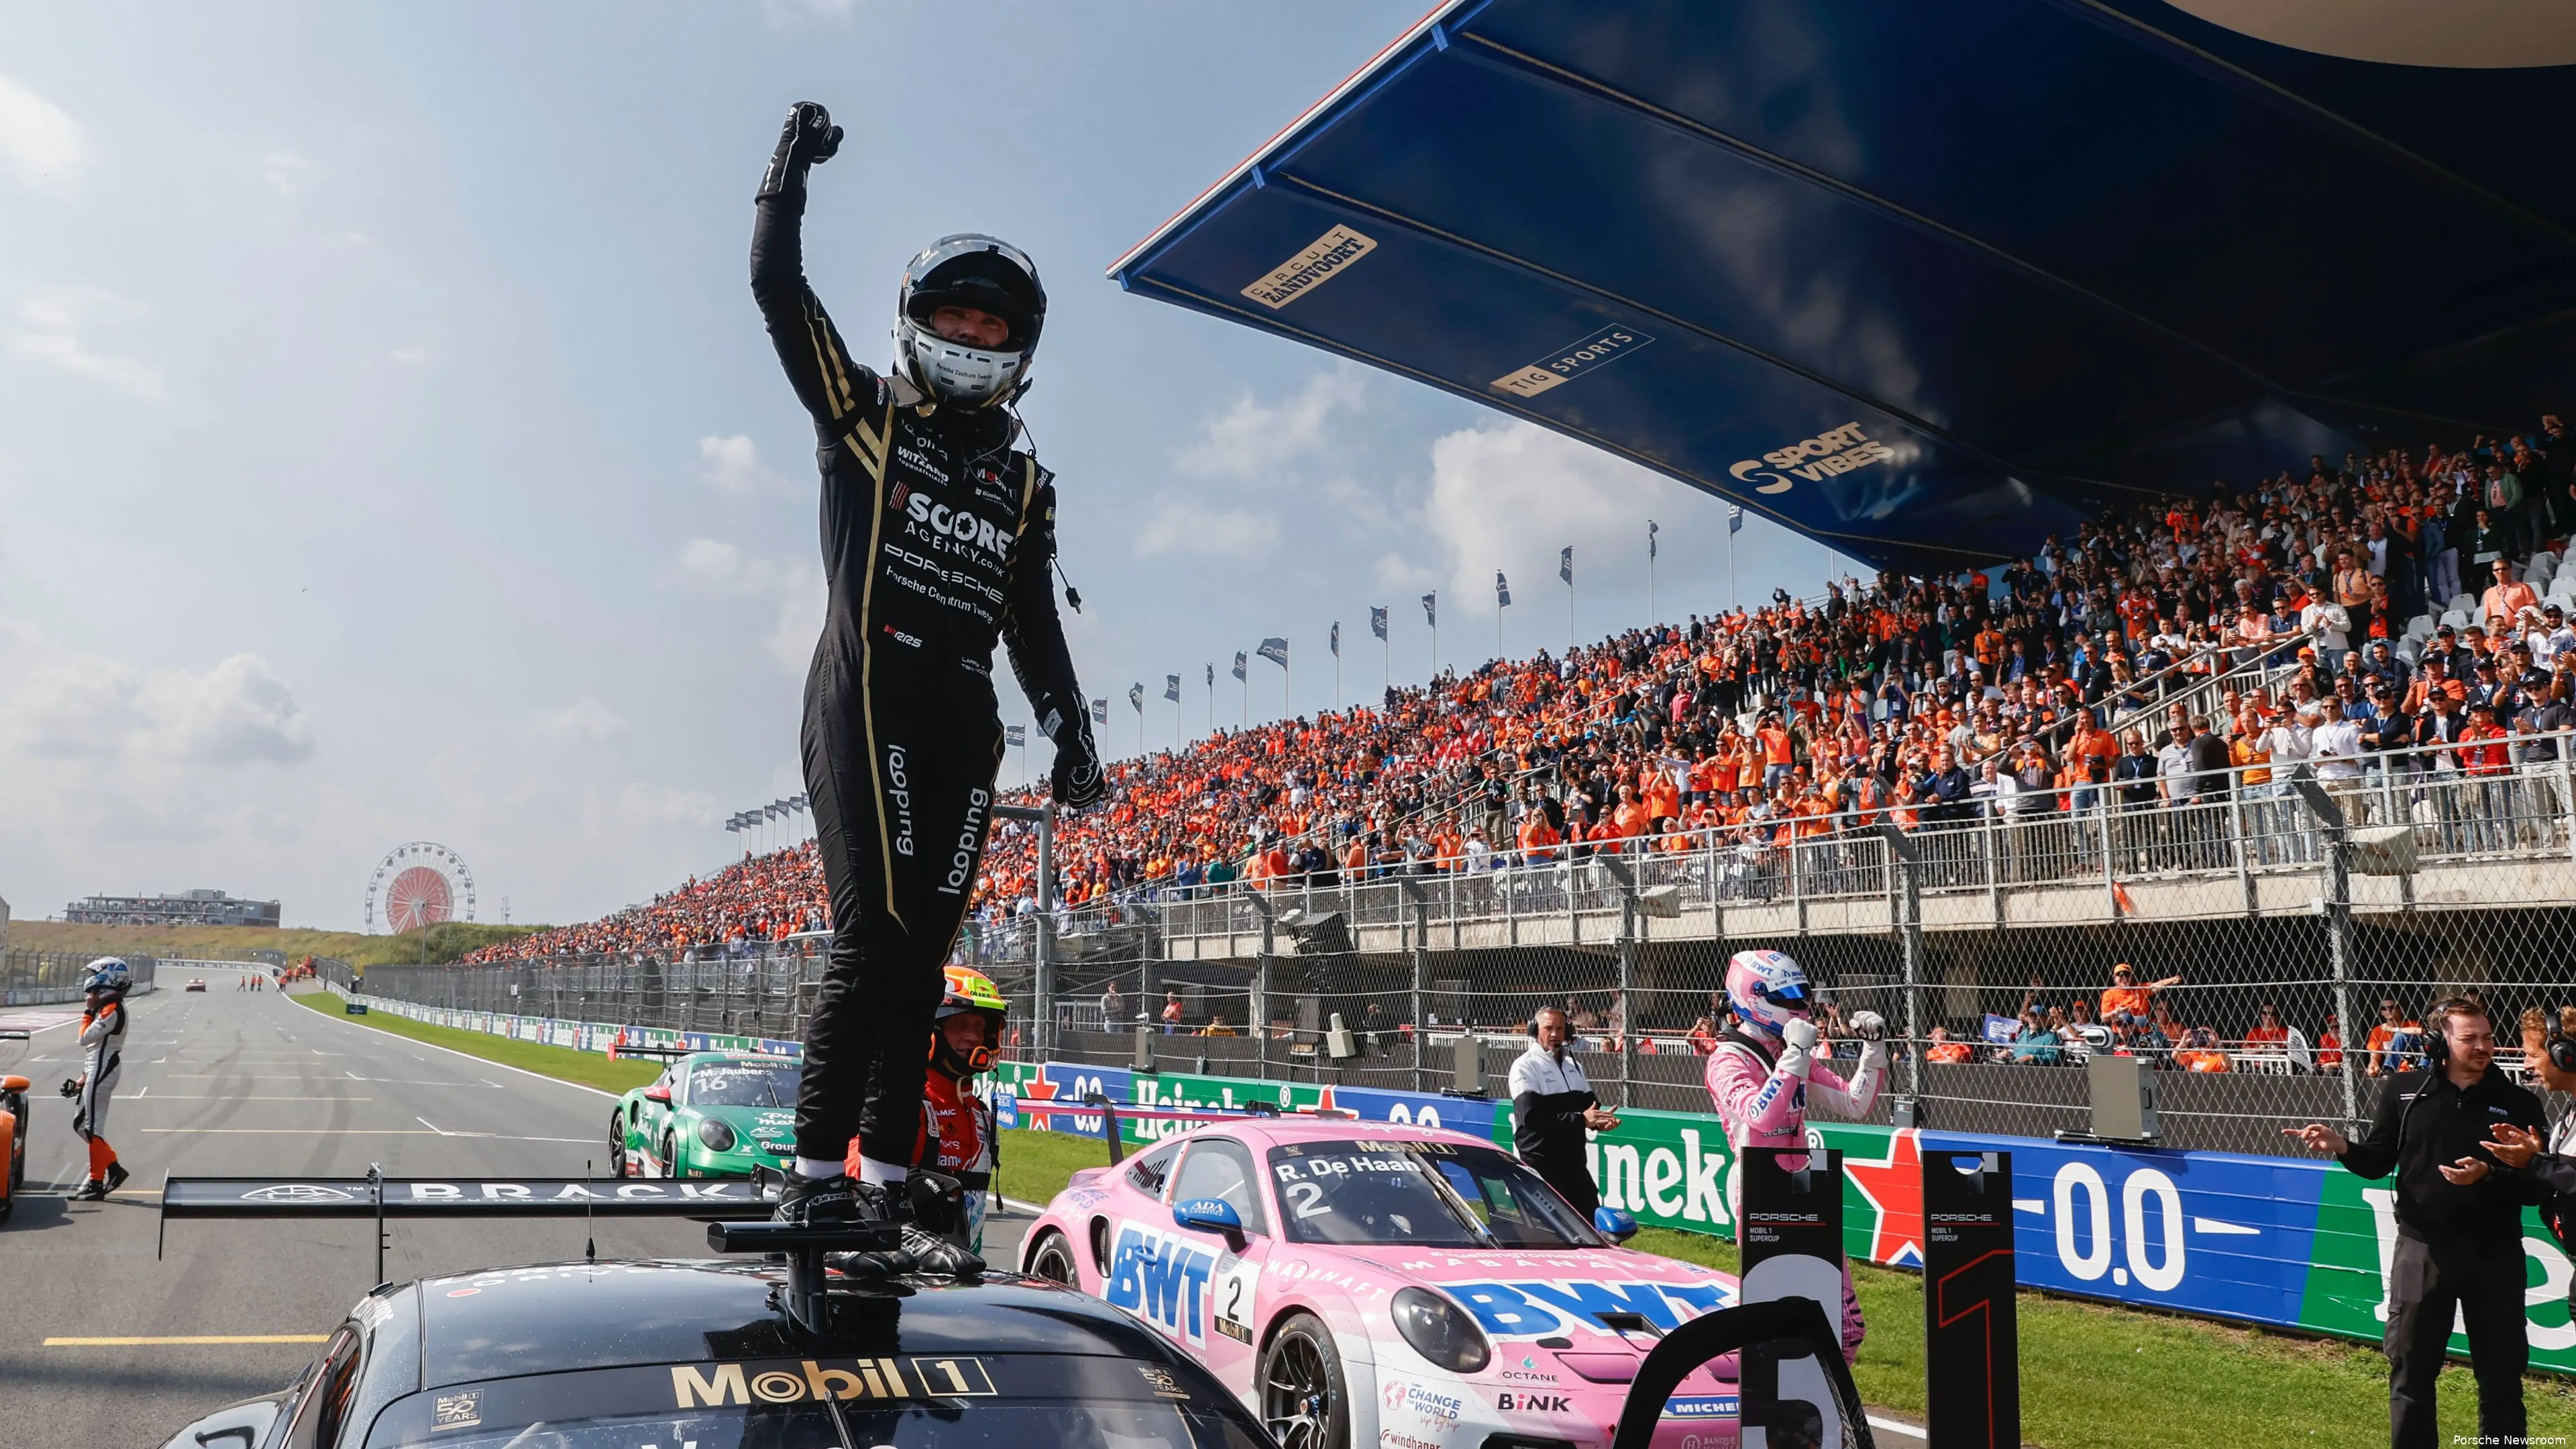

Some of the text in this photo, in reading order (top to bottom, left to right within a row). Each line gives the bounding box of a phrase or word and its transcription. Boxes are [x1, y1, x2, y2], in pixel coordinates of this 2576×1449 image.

[1251, 231, 1344, 295] CIRCUIT
[1261, 237, 1364, 303] ZANDVOORT
[1509, 331, 1633, 390] TIG SPORTS
[1764, 421, 1870, 469] SPORT
[898, 445, 949, 482] WITZAND
[1789, 441, 1894, 482] VIBES
[906, 492, 1014, 562] SCORE
[885, 543, 1004, 604] PORSCHE
[888, 744, 914, 857] looping
[938, 788, 989, 895] looping
[1750, 961, 1774, 975] BWT
[695, 1077, 728, 1094] 16
[701, 1070, 716, 1078] M.
[1760, 1076, 1783, 1111] BWT
[1355, 1140, 1431, 1153] Mobil
[1275, 1156, 1422, 1182] R. De Haan
[410, 1183, 779, 1199] BRACK
[1286, 1181, 1332, 1219] 2
[1192, 1201, 1224, 1212] ADA
[1750, 1214, 1818, 1222] PORSCHE
[1931, 1214, 1992, 1222] PORSCHE
[2053, 1162, 2186, 1291] 0.0
[1106, 1227, 1215, 1340] BWT
[1265, 1258, 1386, 1301] MABANAFT
[1227, 1276, 1242, 1322] 2
[1436, 1280, 1740, 1337] BWT
[1220, 1318, 1239, 1338] Mobil
[671, 1358, 910, 1409] Mobil
[1503, 1371, 1559, 1383] OCTANE
[437, 1393, 468, 1405] Mobil
[437, 1399, 477, 1416] 50
[1408, 1388, 1462, 1411] CHANGE
[1415, 1401, 1458, 1420] WORLD
[1498, 1393, 1573, 1413] BiNK
[437, 1411, 478, 1424] YEARS
[1704, 1437, 1735, 1446] BANQUE
